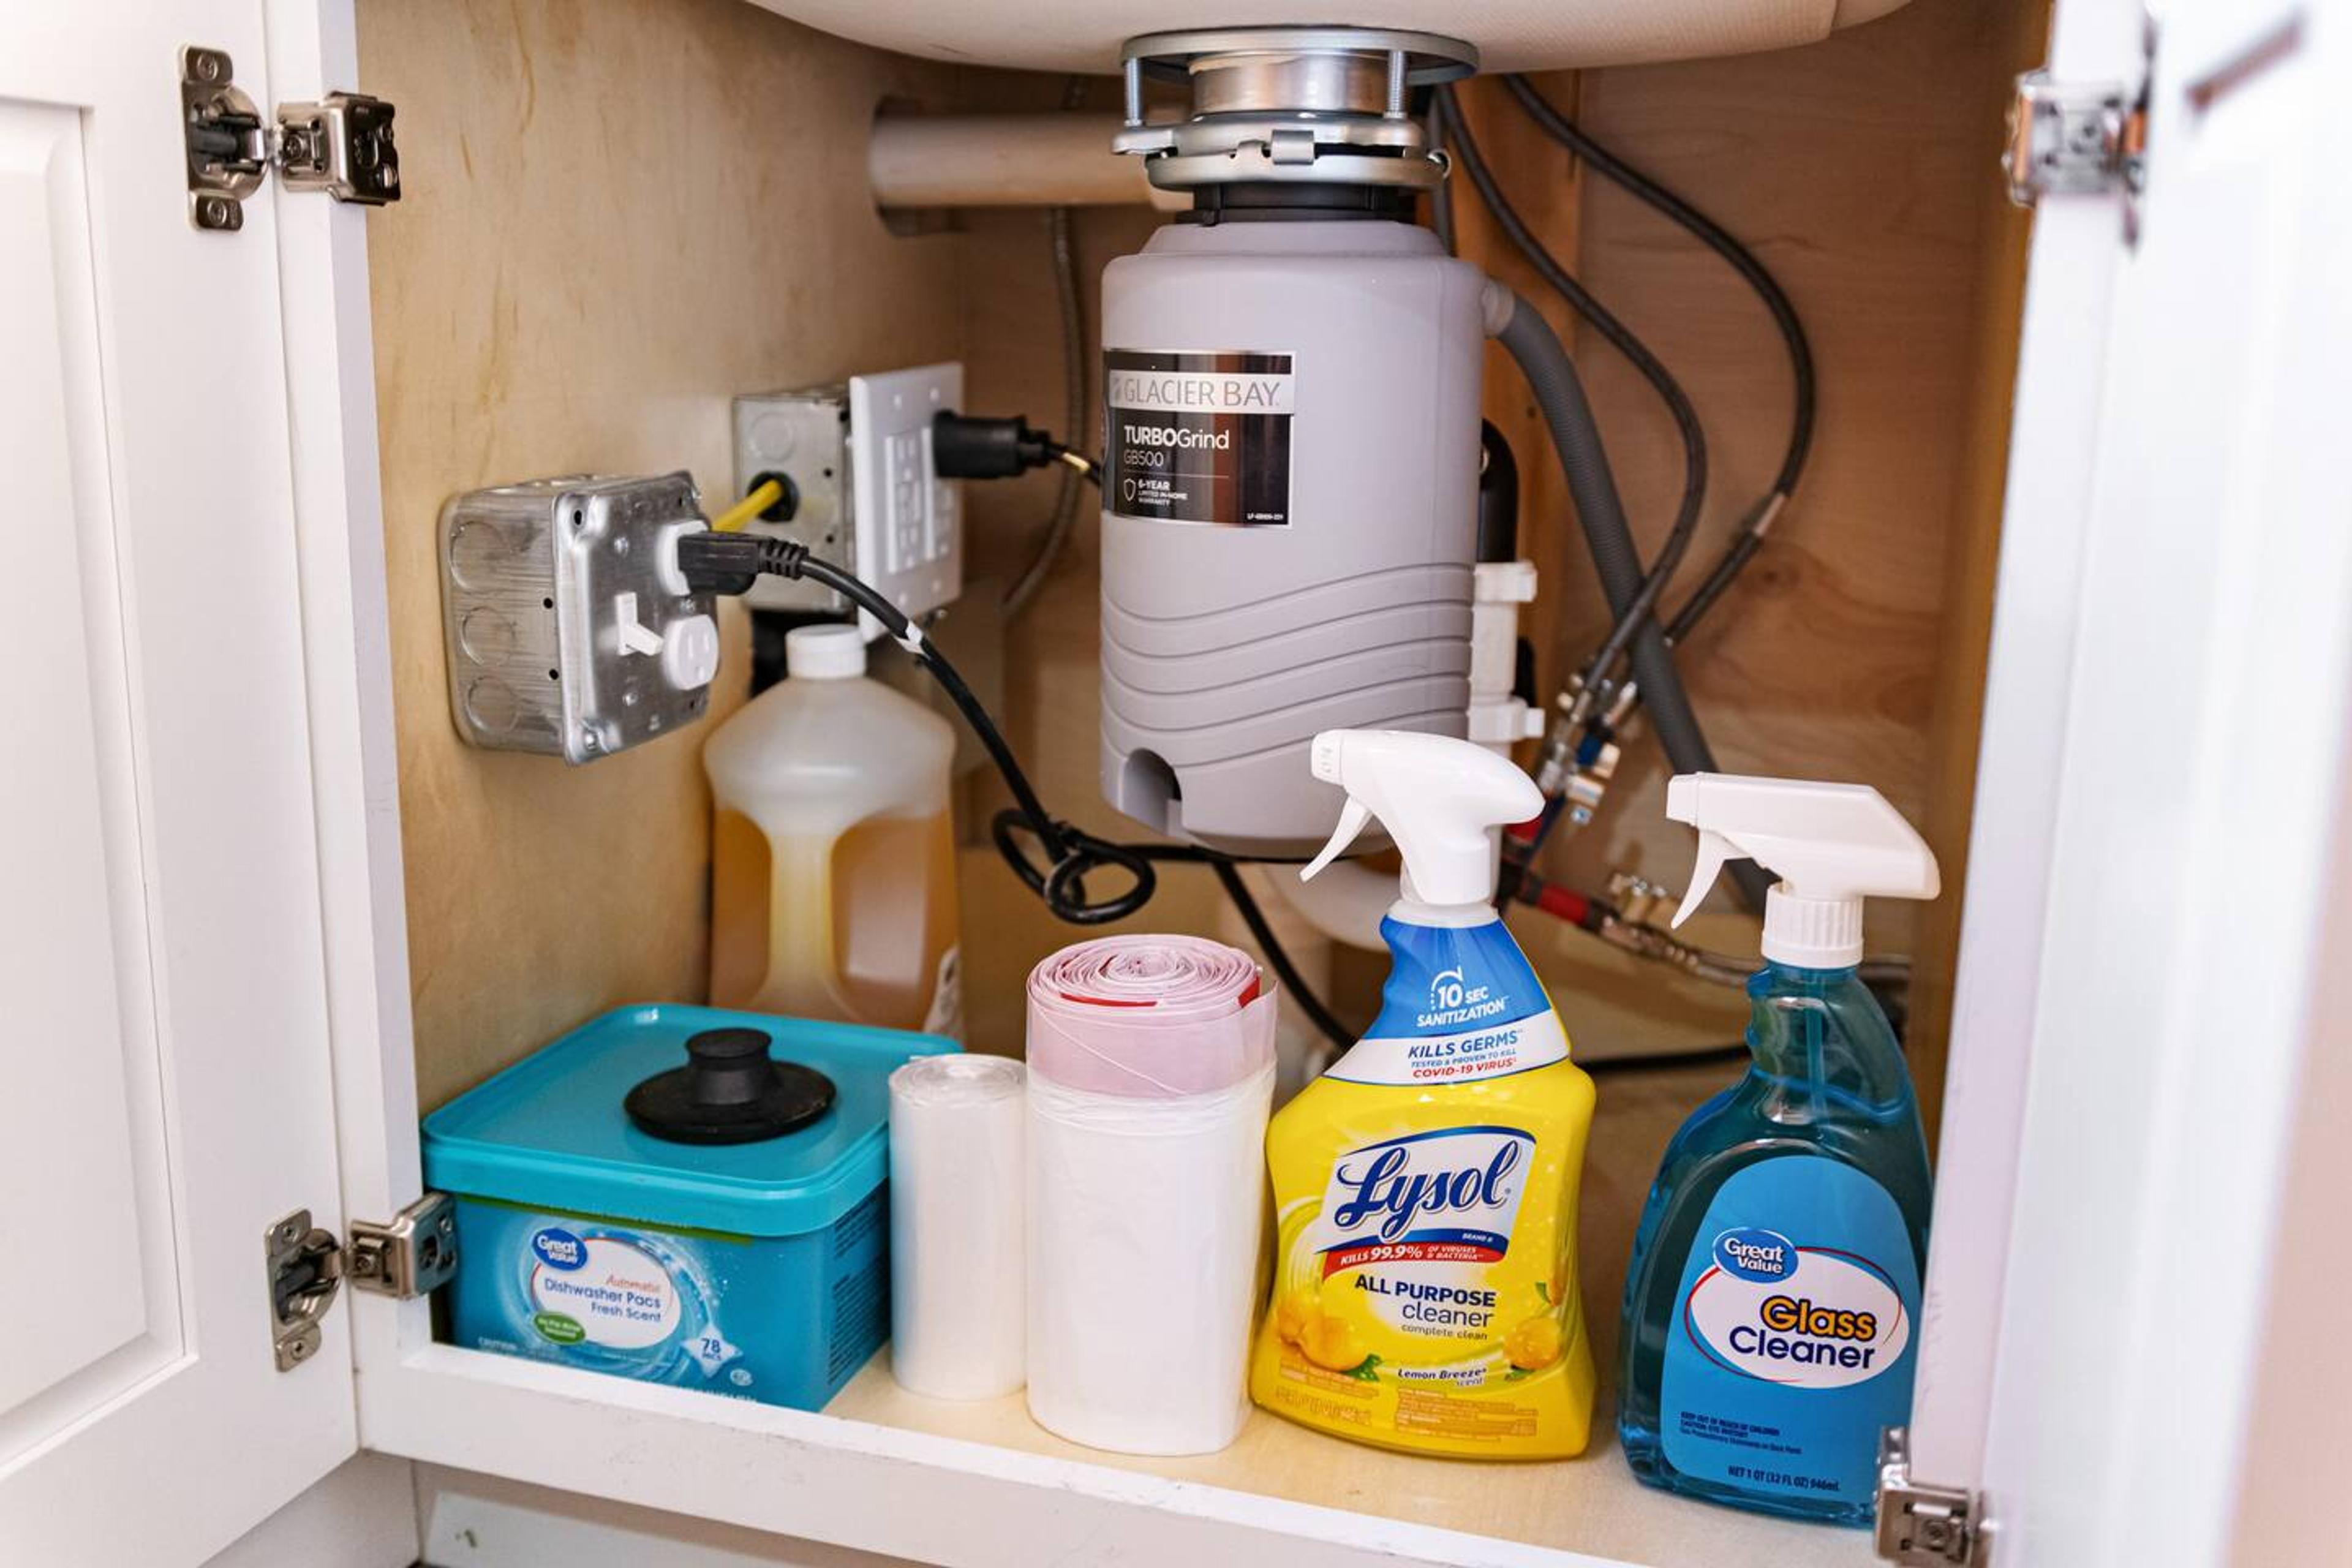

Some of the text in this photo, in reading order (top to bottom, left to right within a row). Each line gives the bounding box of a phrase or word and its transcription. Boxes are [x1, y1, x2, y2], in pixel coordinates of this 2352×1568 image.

[1124, 378, 1280, 406] GLACIER BAY
[1123, 424, 1229, 450] TURBOGrind
[1123, 449, 1164, 467] GB500
[1139, 478, 1170, 491] 6-YEAR
[1438, 983, 1490, 1009] 10 SEC
[1417, 997, 1506, 1027] SANITIZATION
[1408, 1030, 1518, 1059] KILLS GERMS
[1411, 1060, 1442, 1069] TESTED
[1452, 1055, 1486, 1065] PROVEN
[1488, 1051, 1499, 1060] TO
[1501, 1048, 1517, 1057] KILL
[1413, 1064, 1473, 1077] COVID-19
[1334, 1140, 1519, 1239] Lysol
[537, 1234, 578, 1256] Great
[1340, 1244, 1423, 1265] KILLS 99.9%
[1724, 1237, 1784, 1263] Great
[548, 1250, 578, 1264] Value
[1737, 1256, 1784, 1274] Value
[545, 1277, 661, 1309] Dishwasher Pacs
[1354, 1273, 1497, 1308] ALL PURPOSE
[591, 1302, 662, 1322] Fresh Scent
[1403, 1302, 1494, 1328] cleaner
[1760, 1294, 1878, 1342] Glass
[1401, 1324, 1488, 1341] complete clean
[700, 1337, 721, 1354] 78
[1728, 1325, 1876, 1369] Cleaner
[1398, 1368, 1436, 1379] Lemon
[1727, 1465, 1745, 1478] NET
